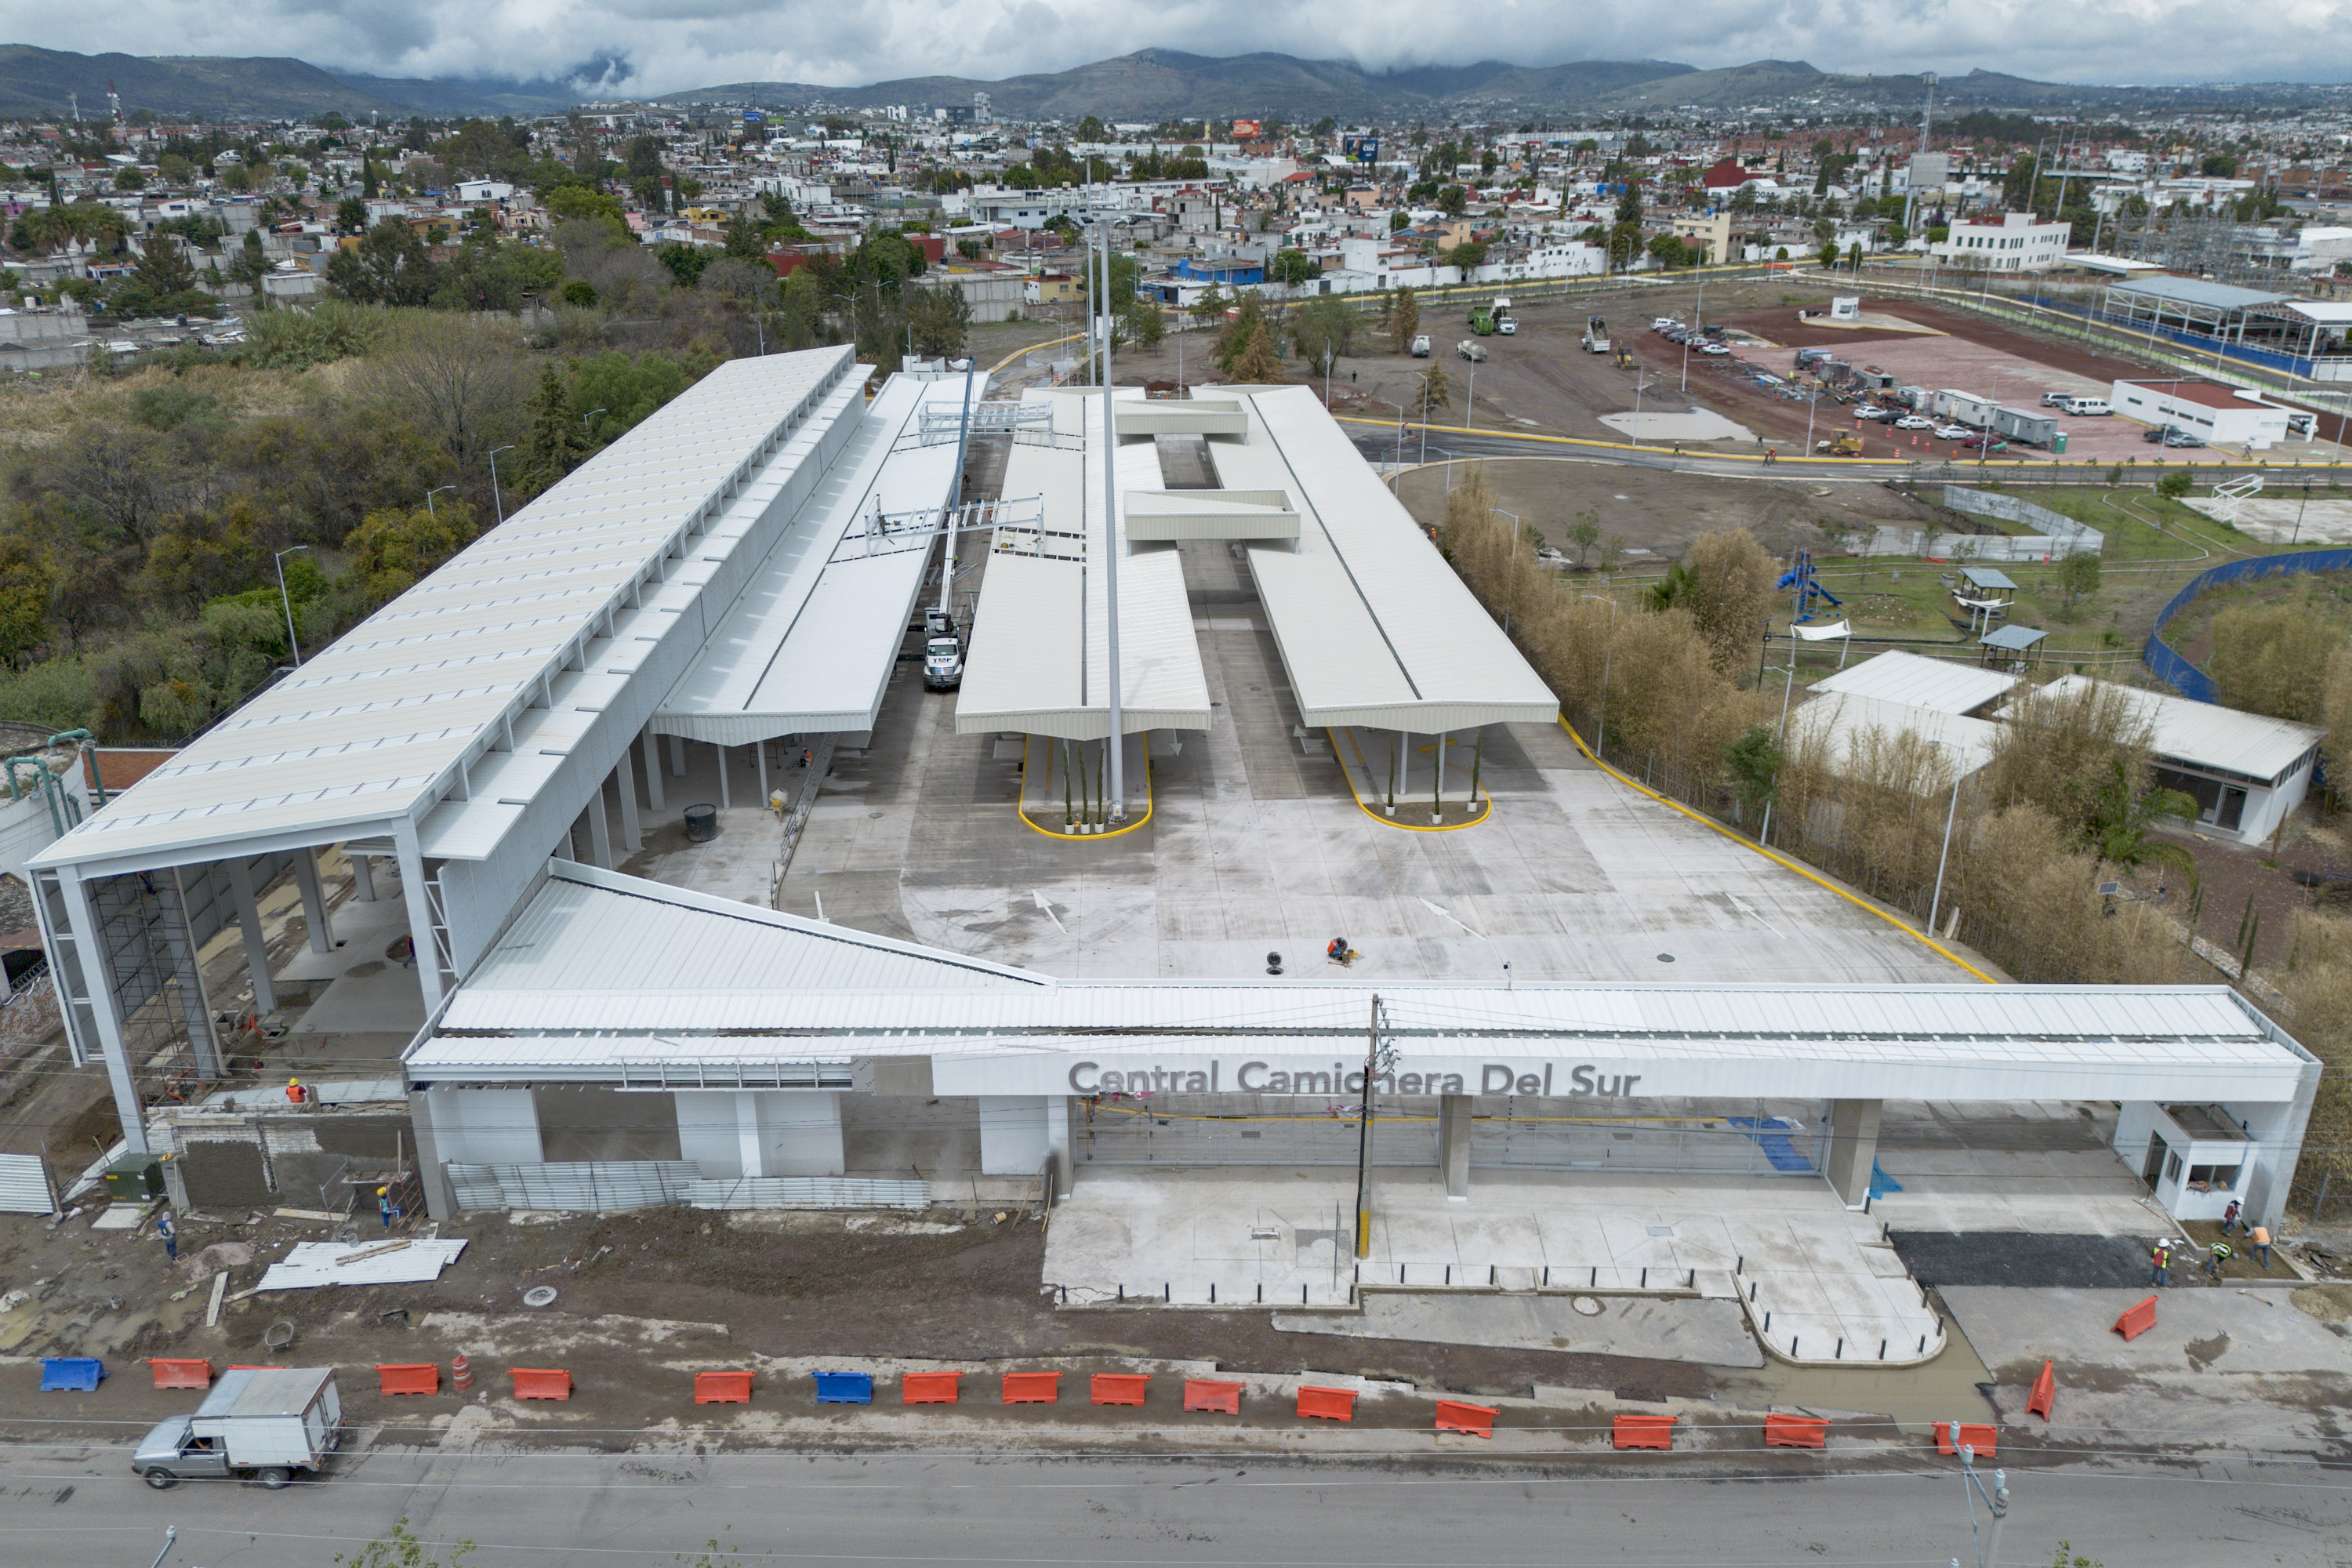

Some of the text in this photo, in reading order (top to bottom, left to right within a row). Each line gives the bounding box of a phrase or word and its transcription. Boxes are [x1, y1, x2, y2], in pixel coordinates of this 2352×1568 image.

[1069, 1059, 1641, 1096] Central Camionera Del Sur
